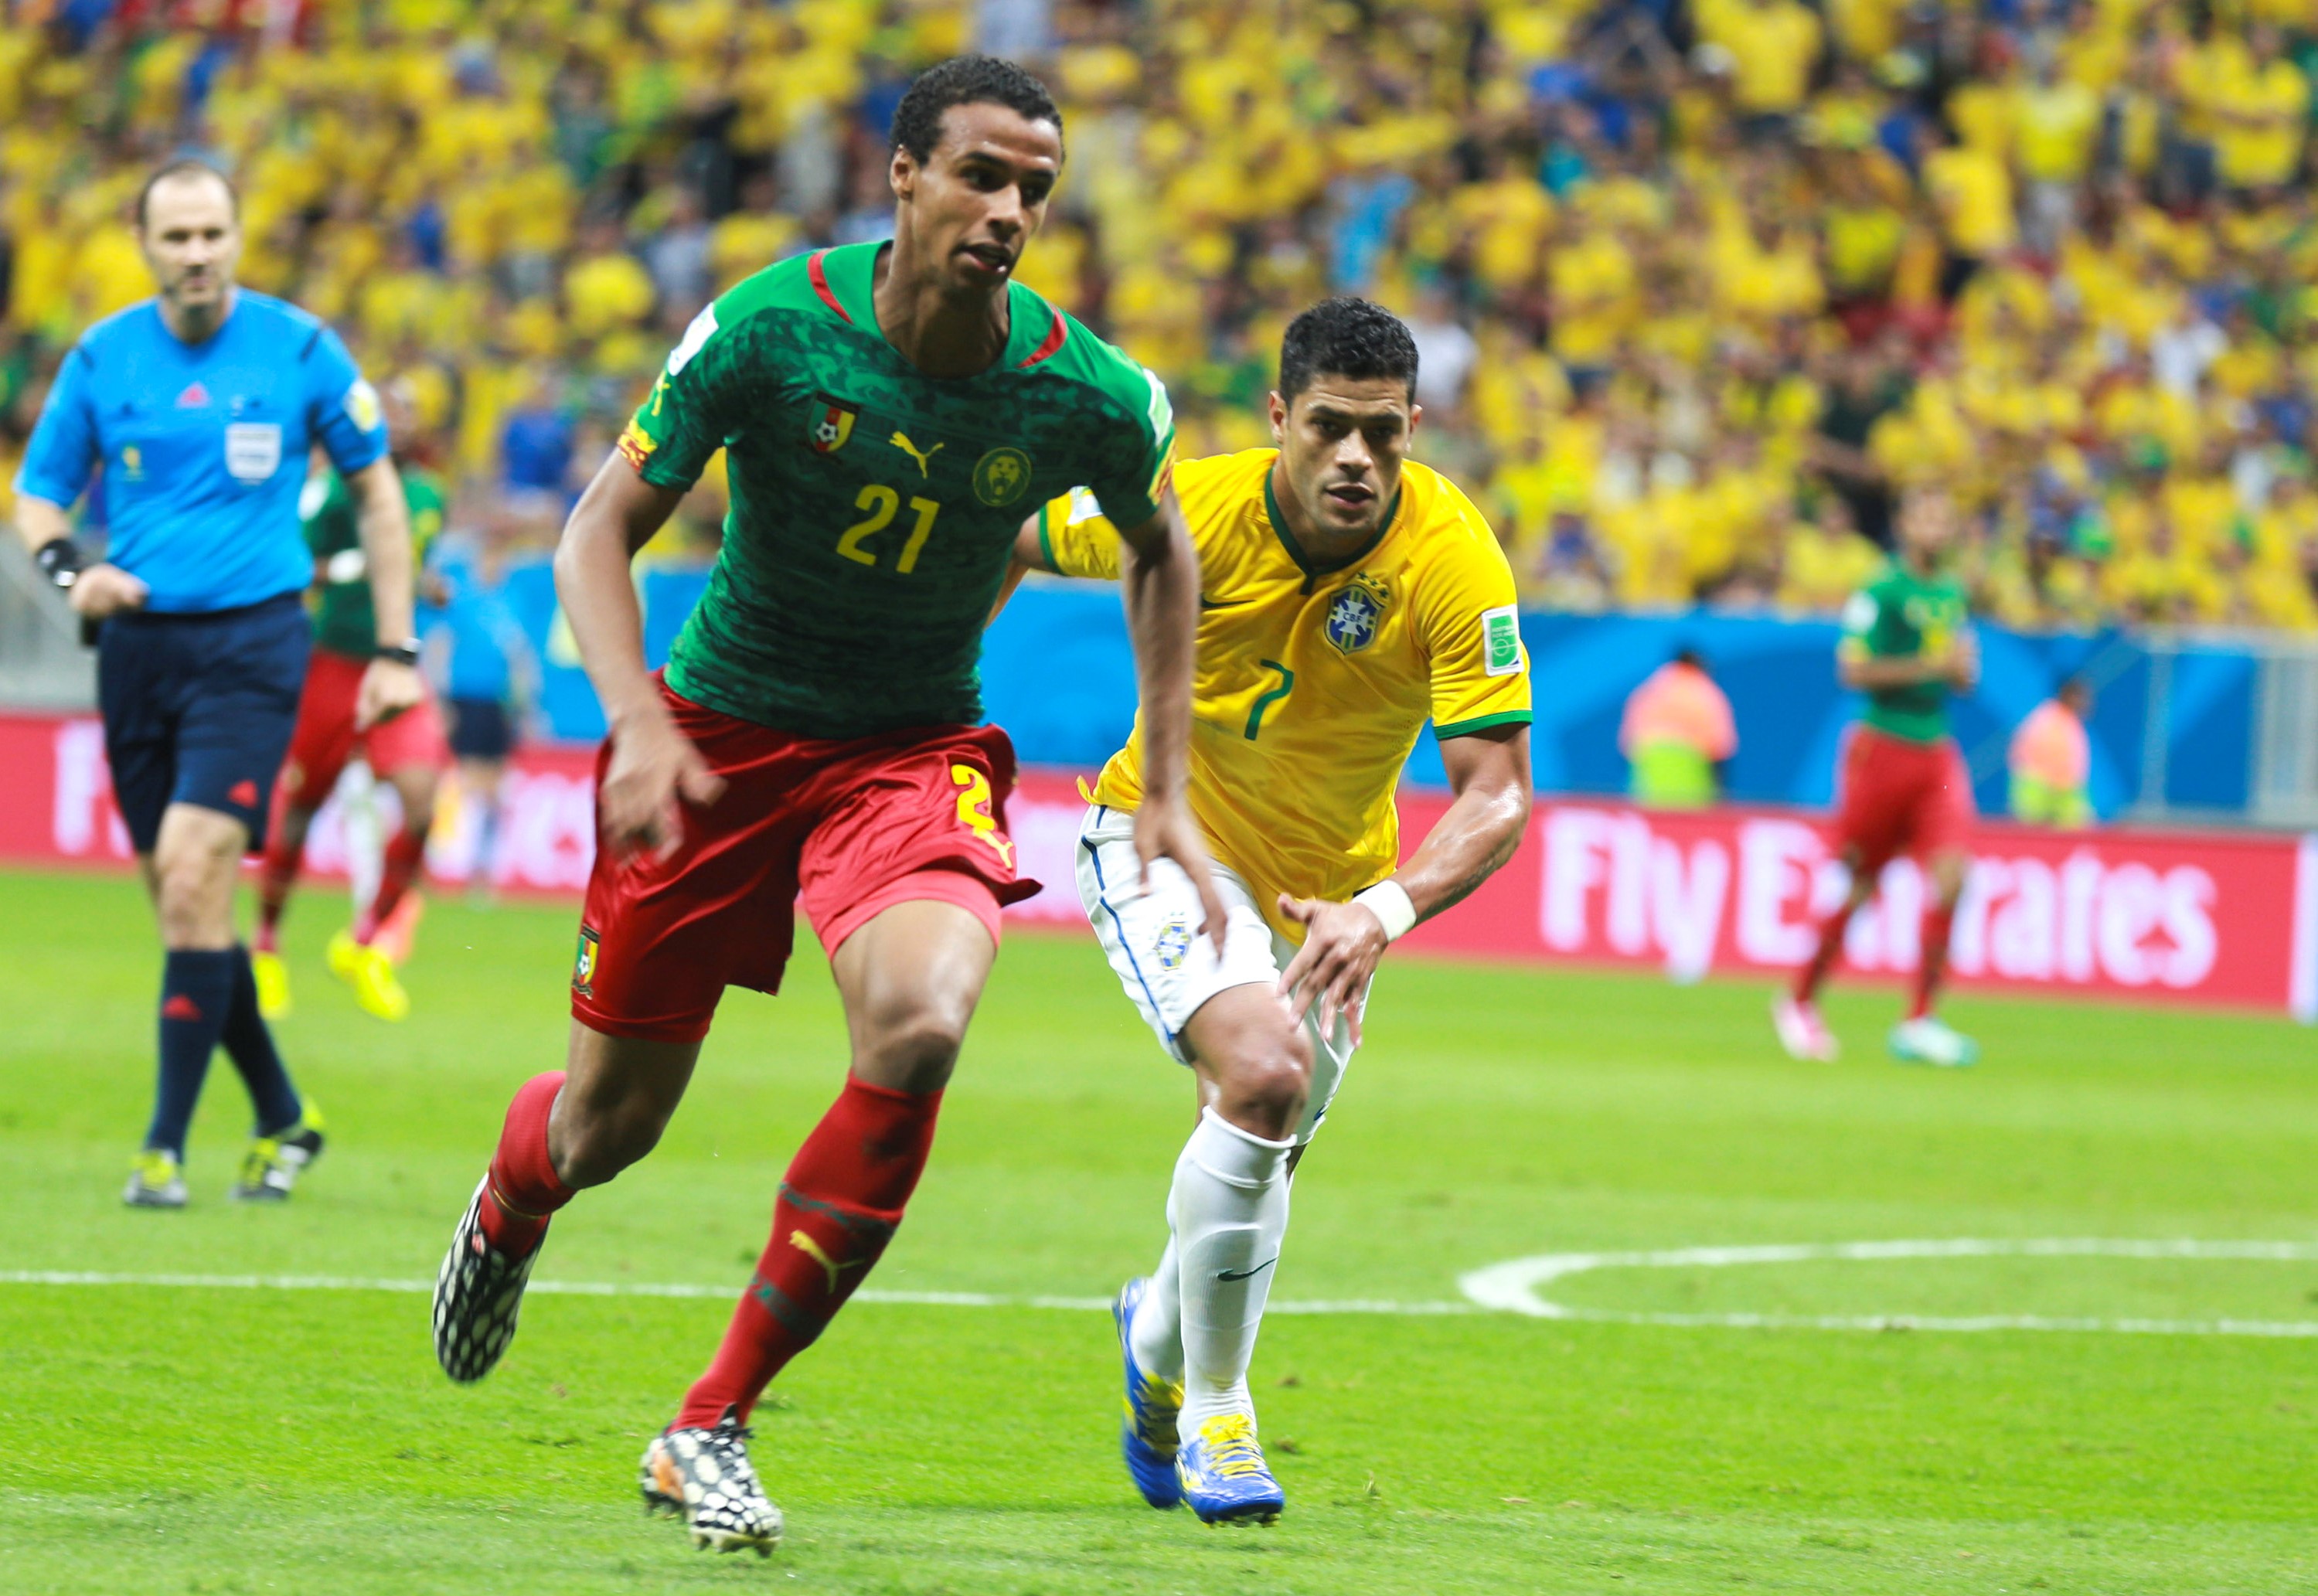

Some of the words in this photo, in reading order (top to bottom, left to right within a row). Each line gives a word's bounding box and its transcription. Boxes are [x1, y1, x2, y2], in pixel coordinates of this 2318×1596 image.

[836, 484, 941, 573] 21
[1244, 658, 1295, 741] 7
[1542, 808, 1729, 982] Fly
